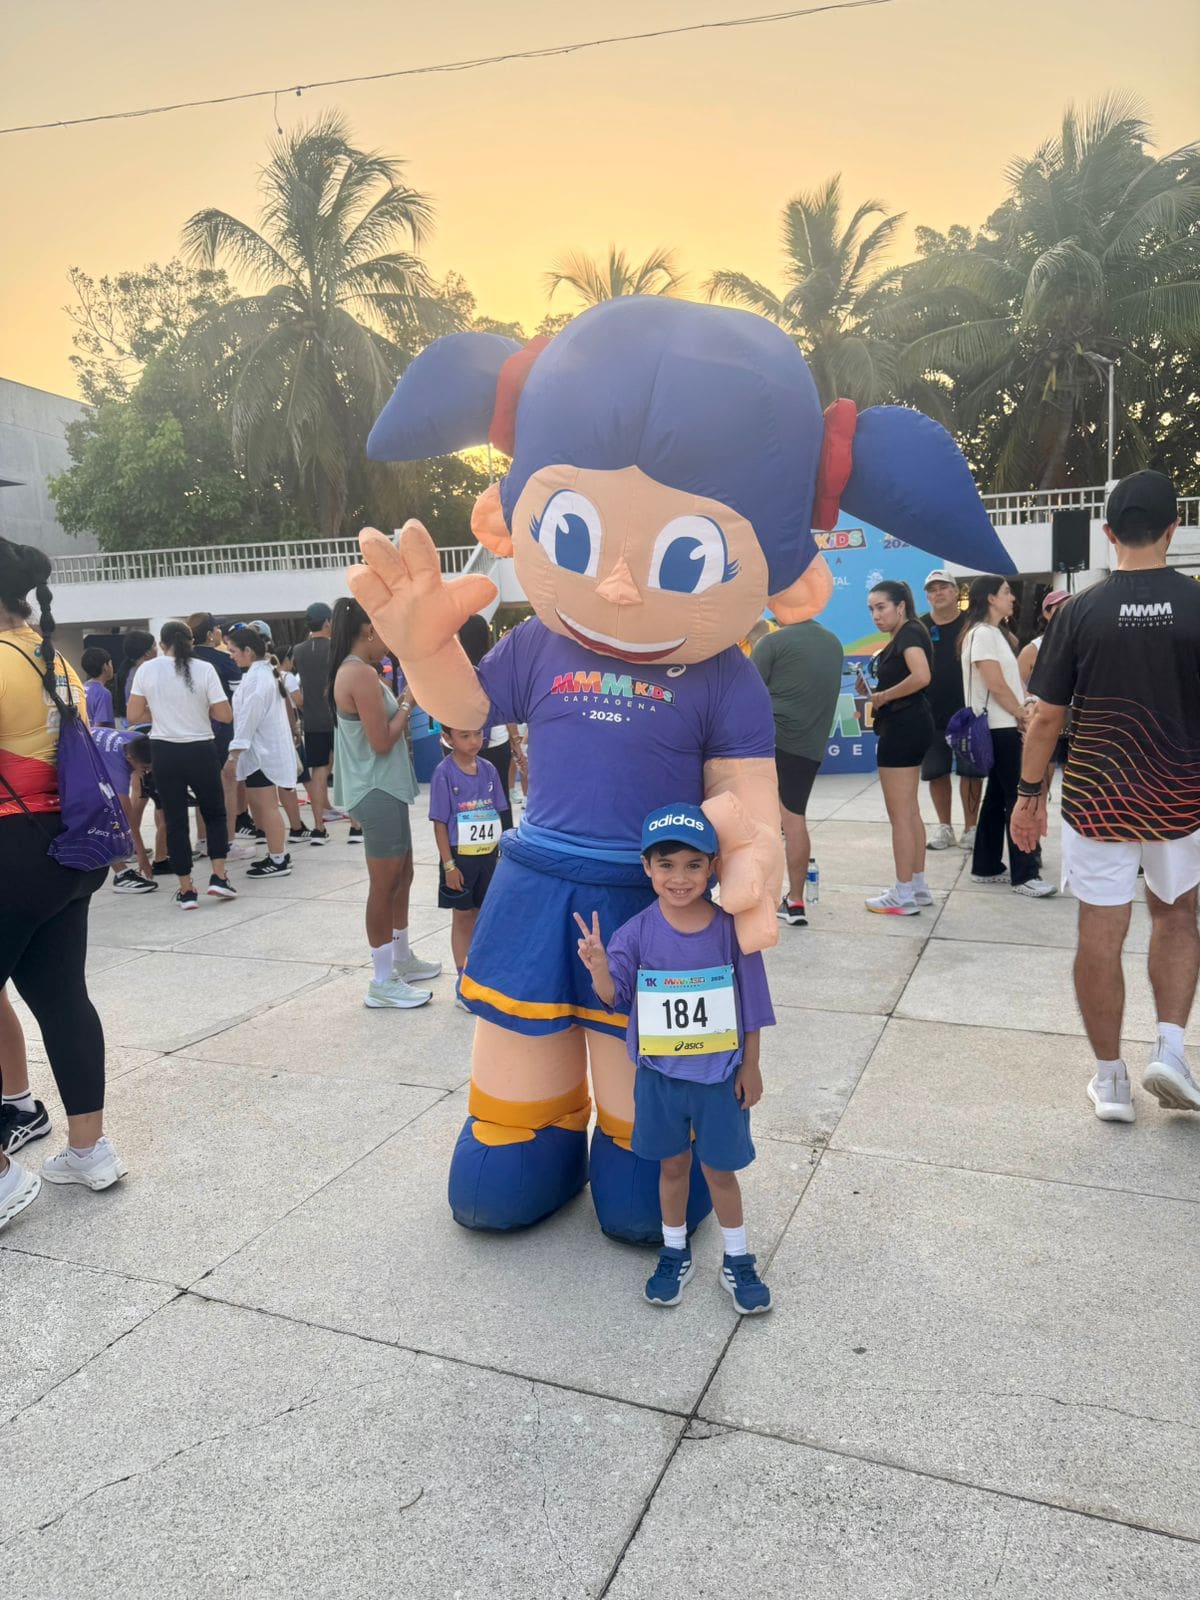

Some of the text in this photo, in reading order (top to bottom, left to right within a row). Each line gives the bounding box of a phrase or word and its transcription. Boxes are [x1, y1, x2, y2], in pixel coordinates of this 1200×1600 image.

[1119, 602, 1173, 617] MMM
[551, 671, 634, 698] MMM
[563, 695, 657, 713] CARTAGENA
[648, 813, 705, 832] adidas
[471, 824, 494, 840] 244
[645, 977, 657, 987] 1K
[662, 997, 708, 1029] 184
